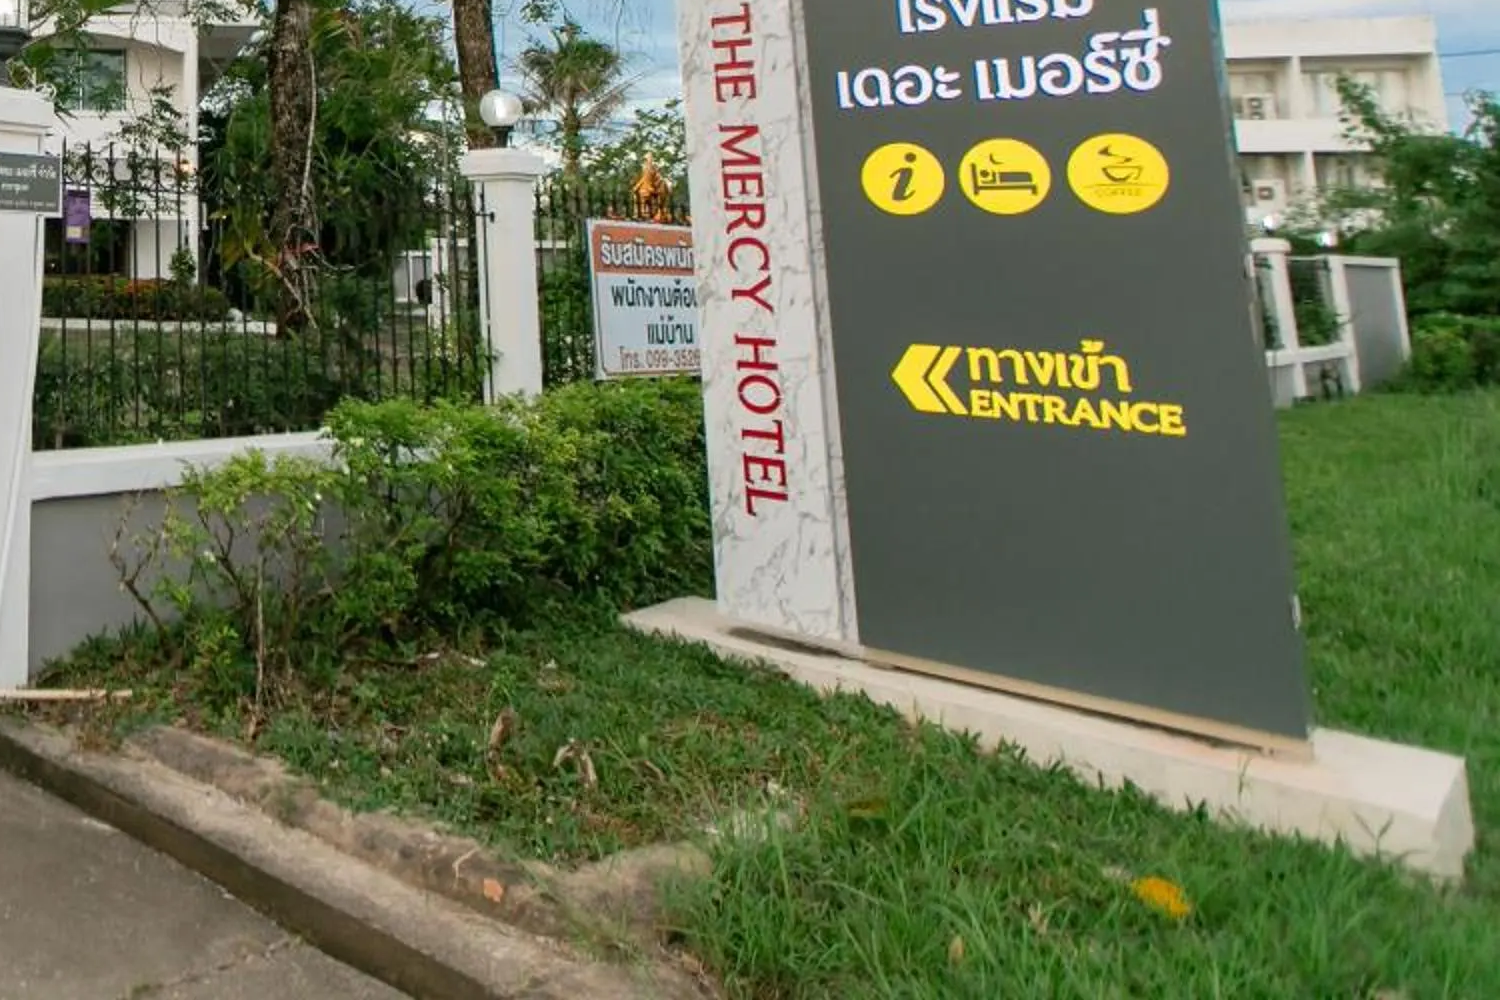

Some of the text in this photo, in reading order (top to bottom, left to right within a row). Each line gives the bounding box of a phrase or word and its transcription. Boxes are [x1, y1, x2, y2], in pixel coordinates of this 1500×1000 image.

[837, 7, 1172, 109] เดอะ เมอร์ซี่
[711, 2, 789, 517] THE MERCY HOTEL
[967, 339, 1132, 393] ทางเข้า
[969, 389, 1187, 436] ENTRANCE
